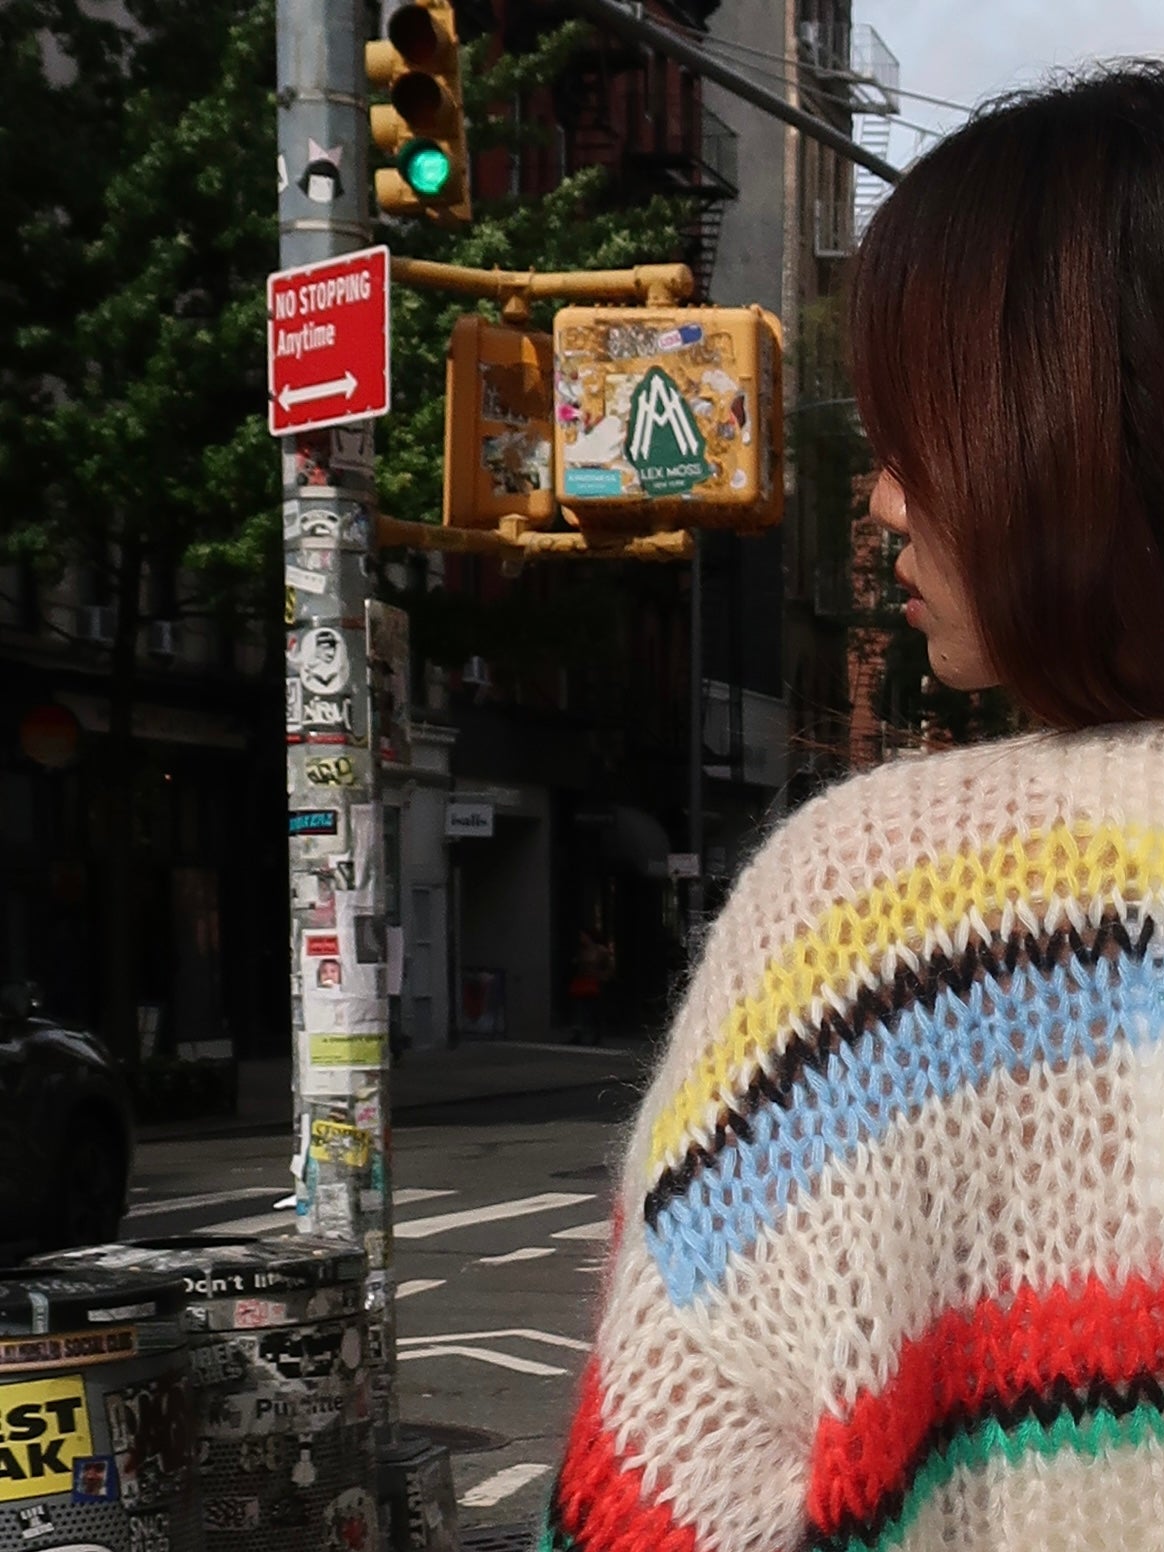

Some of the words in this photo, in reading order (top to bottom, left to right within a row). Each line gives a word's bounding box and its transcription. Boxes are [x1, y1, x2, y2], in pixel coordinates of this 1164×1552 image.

[275, 289, 296, 320] NO
[299, 270, 371, 316] STOPPING
[276, 321, 335, 359] Anytime
[0, 1397, 82, 1443] ST
